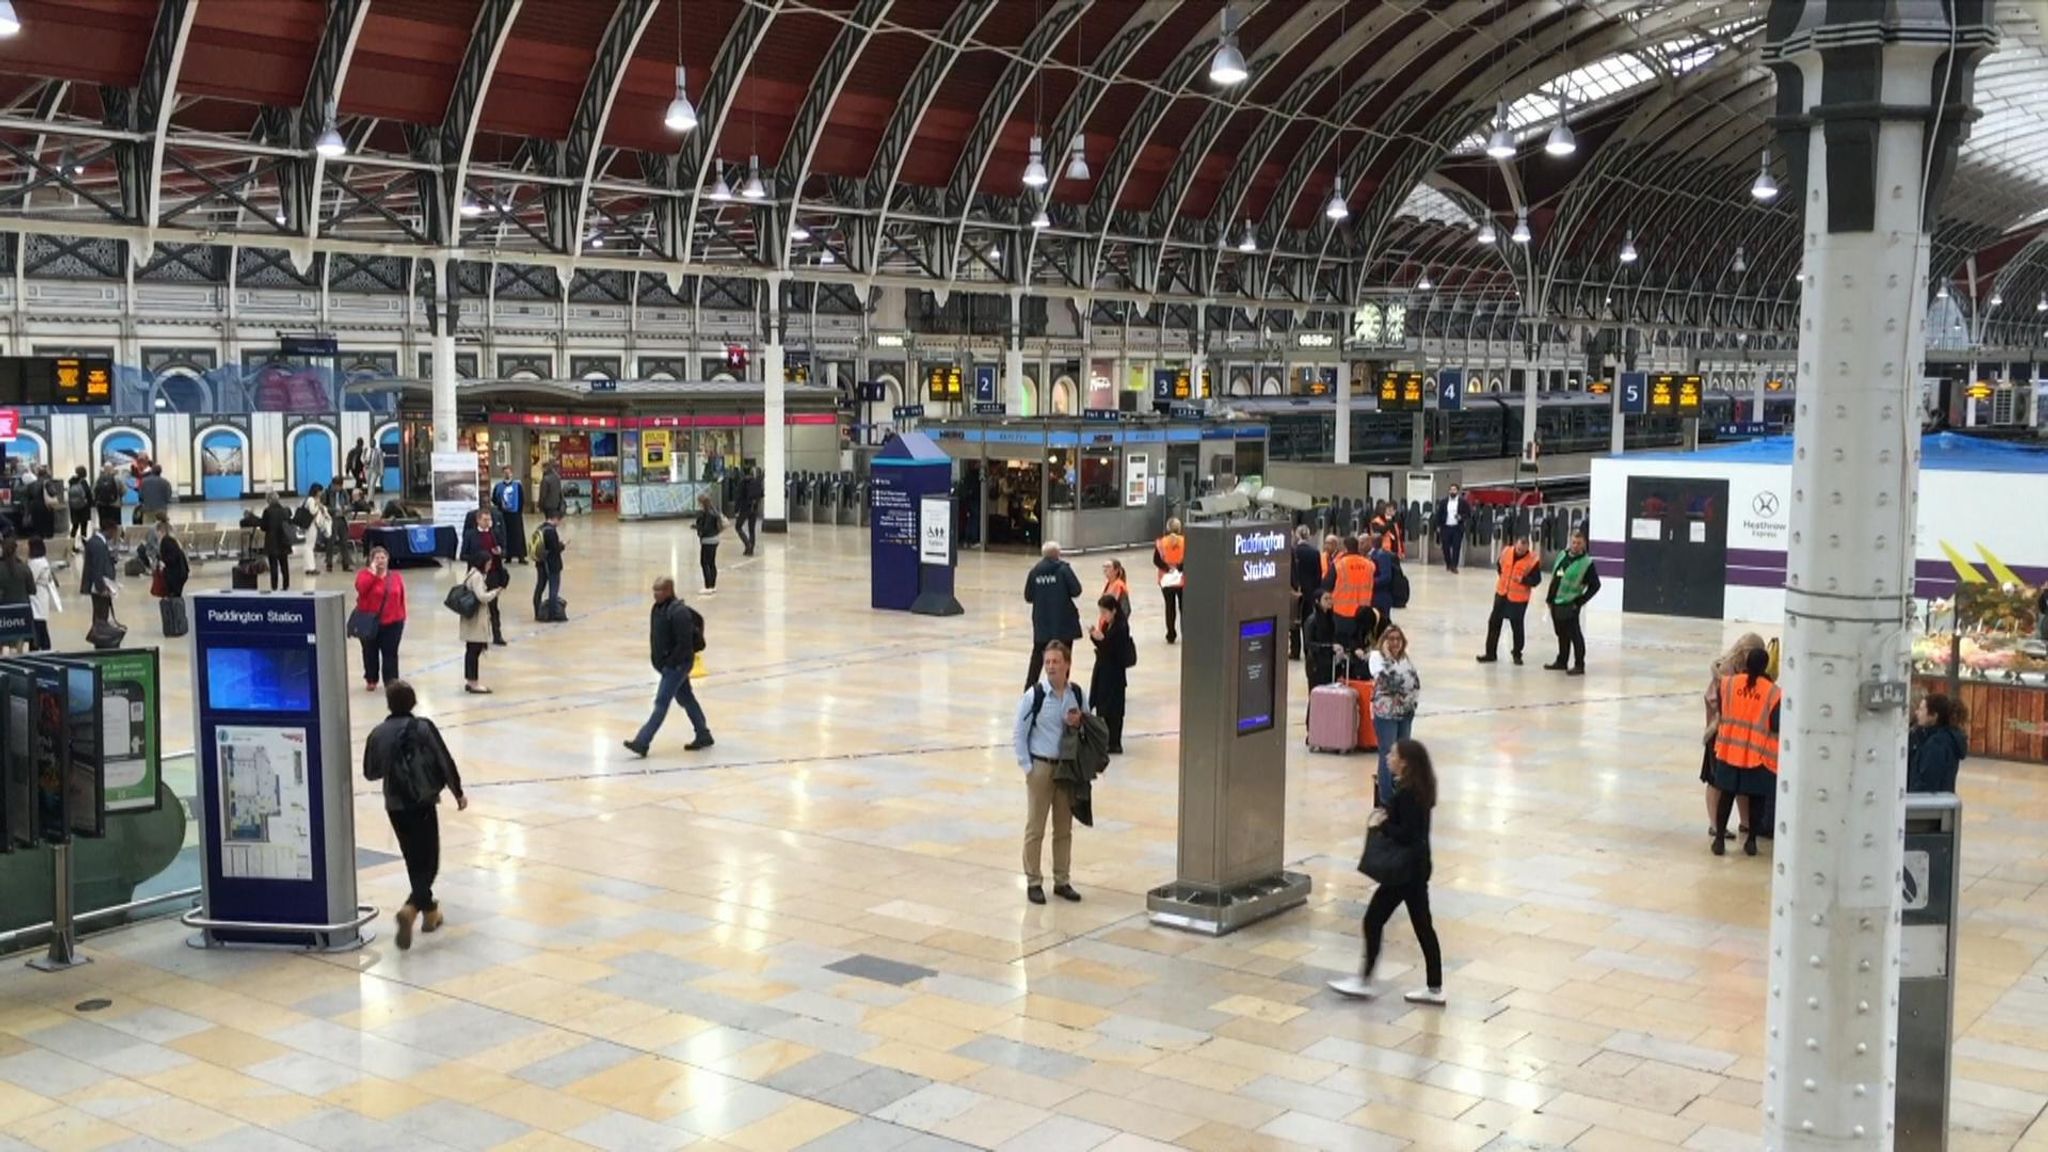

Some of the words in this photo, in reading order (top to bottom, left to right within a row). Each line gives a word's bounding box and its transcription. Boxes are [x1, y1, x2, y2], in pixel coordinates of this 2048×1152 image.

[981, 377, 989, 391] 2
[1159, 380, 1168, 395] 3
[1444, 383, 1455, 399] 4
[1626, 385, 1638, 402] 5
[1743, 520, 1787, 530] Heathrow
[1752, 530, 1777, 538] Express
[1235, 530, 1285, 556] Paddington
[1243, 559, 1276, 581] Station
[207, 609, 264, 625] Paddington
[266, 609, 304, 623] Station
